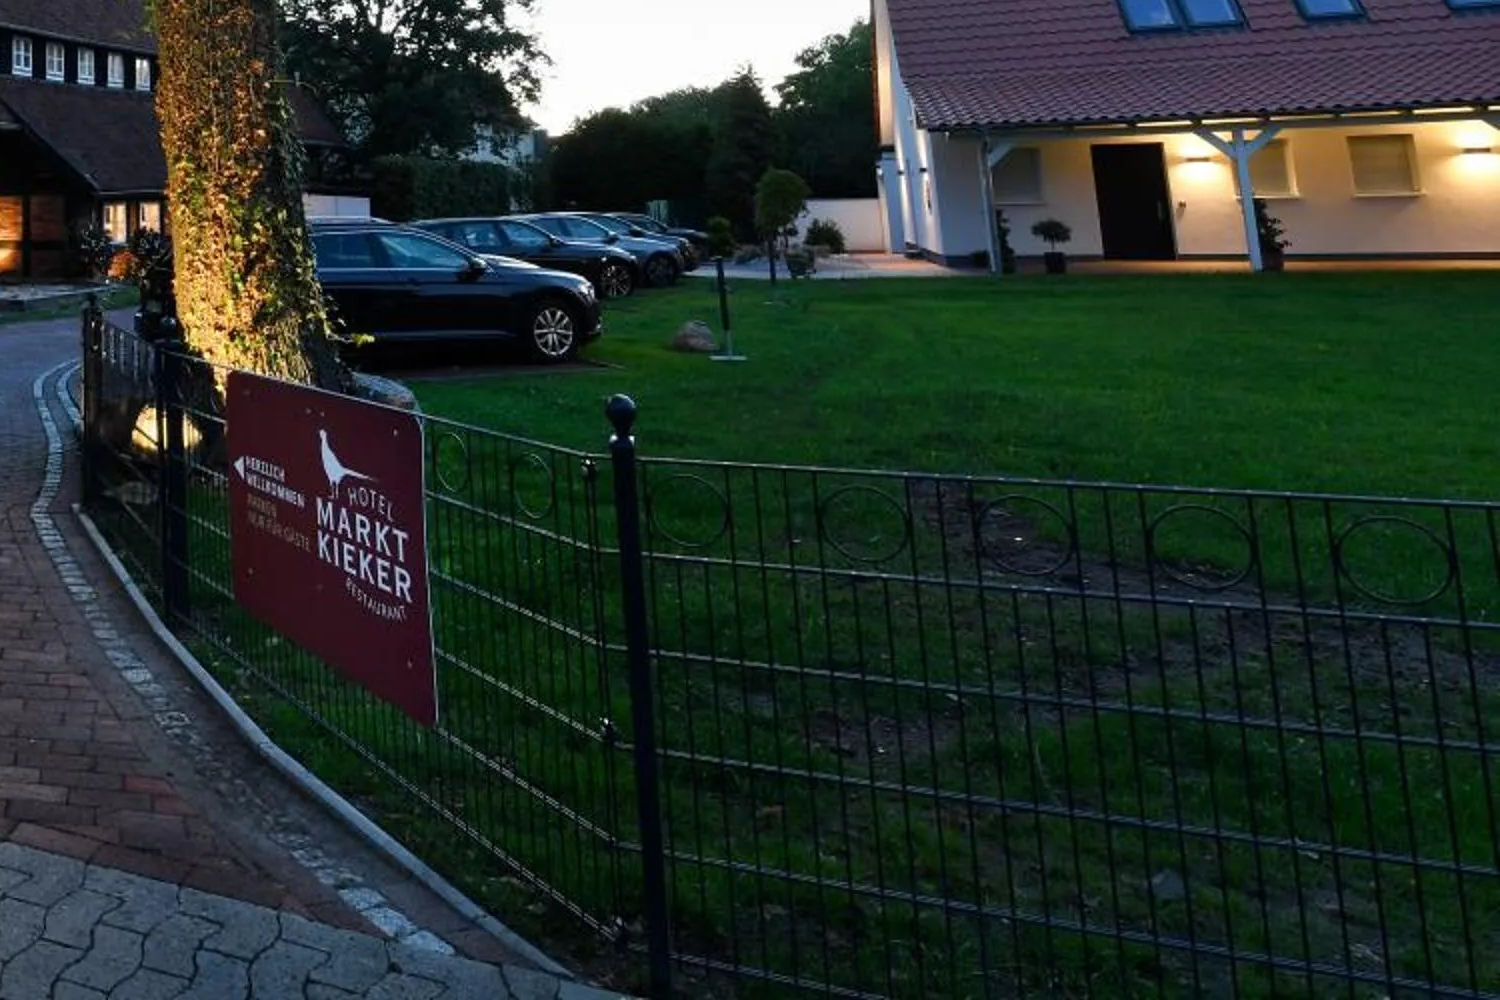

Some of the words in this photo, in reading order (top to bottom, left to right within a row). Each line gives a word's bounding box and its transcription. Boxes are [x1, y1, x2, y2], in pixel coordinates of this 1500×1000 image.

[245, 456, 285, 482] HERZLICH
[246, 472, 305, 508] WILLKOMMEN
[347, 487, 393, 522] HOTEL
[316, 496, 408, 562] MARKT
[317, 529, 412, 603] KIEKER
[346, 578, 407, 621] RESTAURANT
